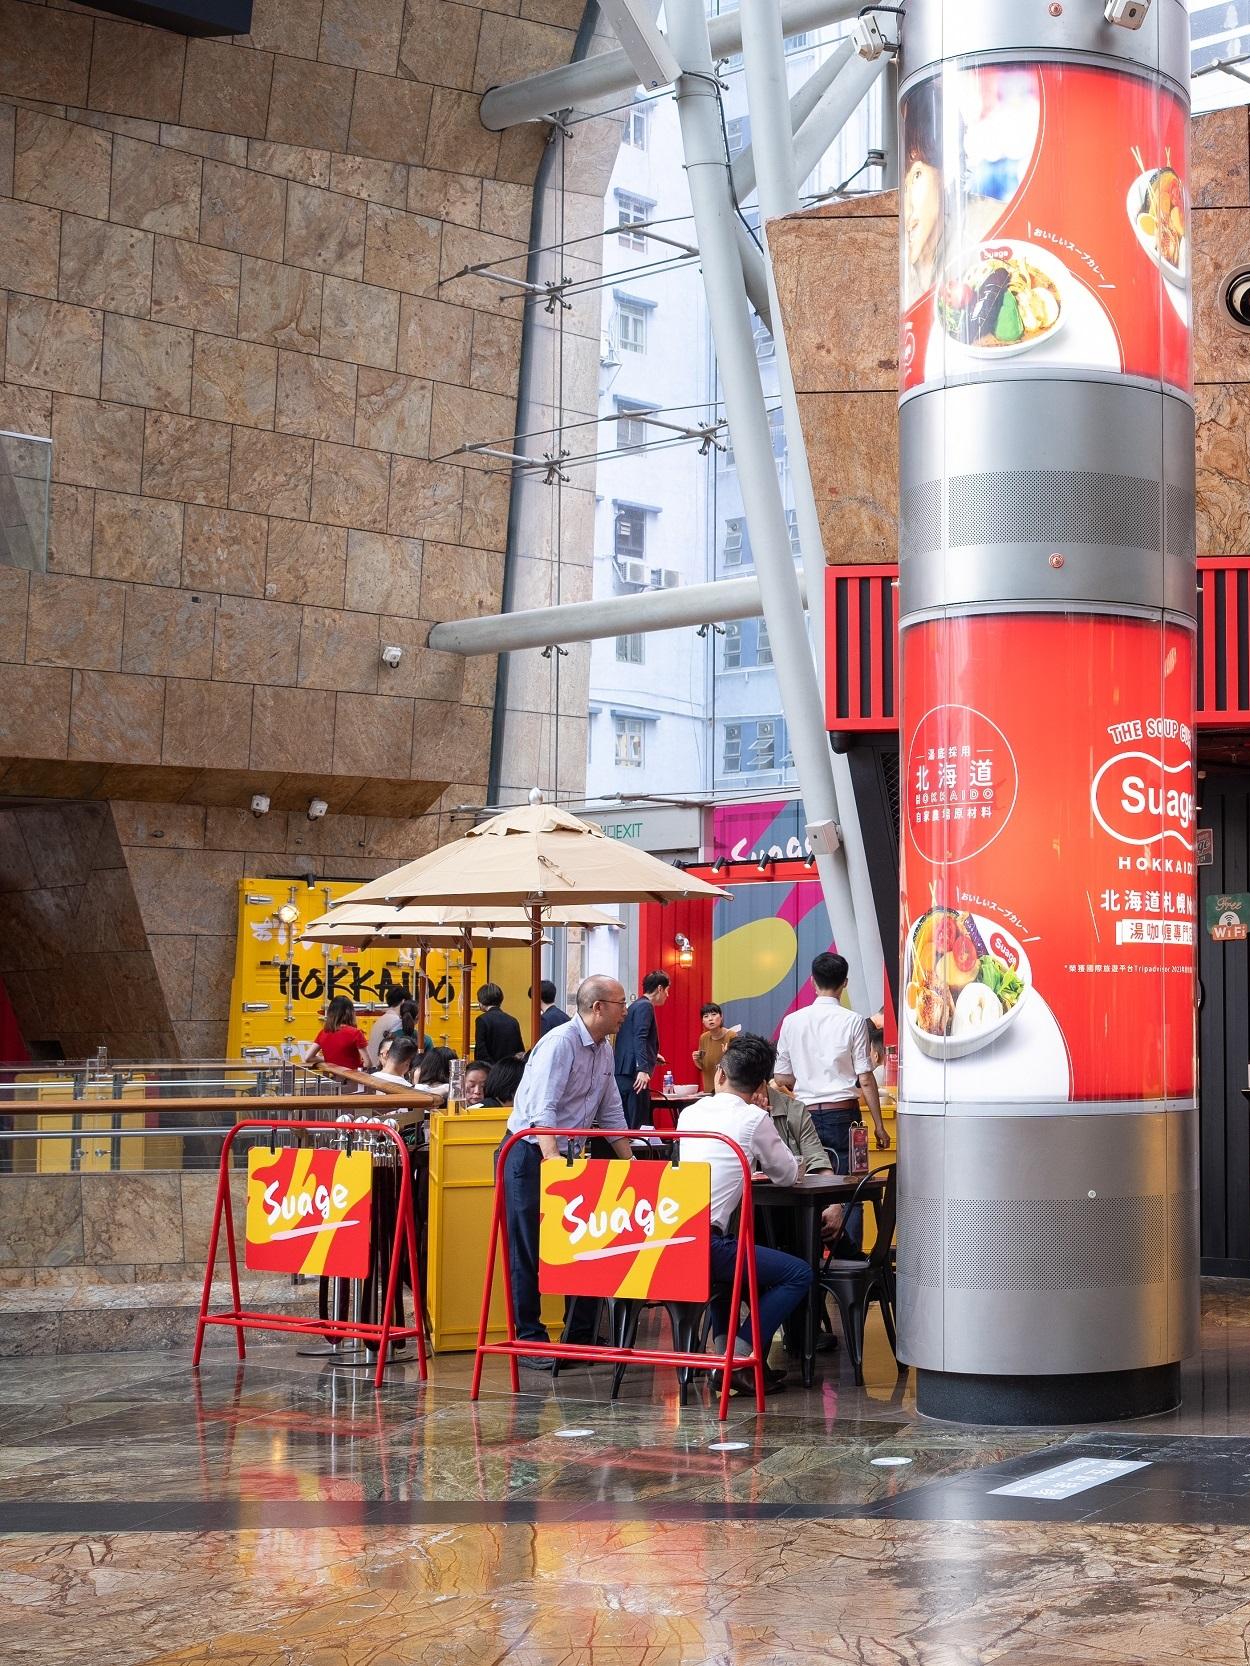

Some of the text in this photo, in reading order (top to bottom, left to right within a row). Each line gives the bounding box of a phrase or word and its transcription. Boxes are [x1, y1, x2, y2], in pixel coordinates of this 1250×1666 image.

[1033, 227, 1105, 281] おいしいスープカレー
[1107, 719, 1143, 744] THE
[1146, 717, 1179, 738] SOUP
[915, 759, 993, 792] 北海道
[915, 788, 993, 805] HOKKAIDO
[1118, 857, 1192, 875] HOKKAID
[960, 892, 1030, 934] おいしいスープカレー
[1215, 896, 1242, 911] Free
[994, 938, 1017, 965] Suage
[263, 1179, 349, 1224] Suage
[563, 1194, 680, 1245] Suage
